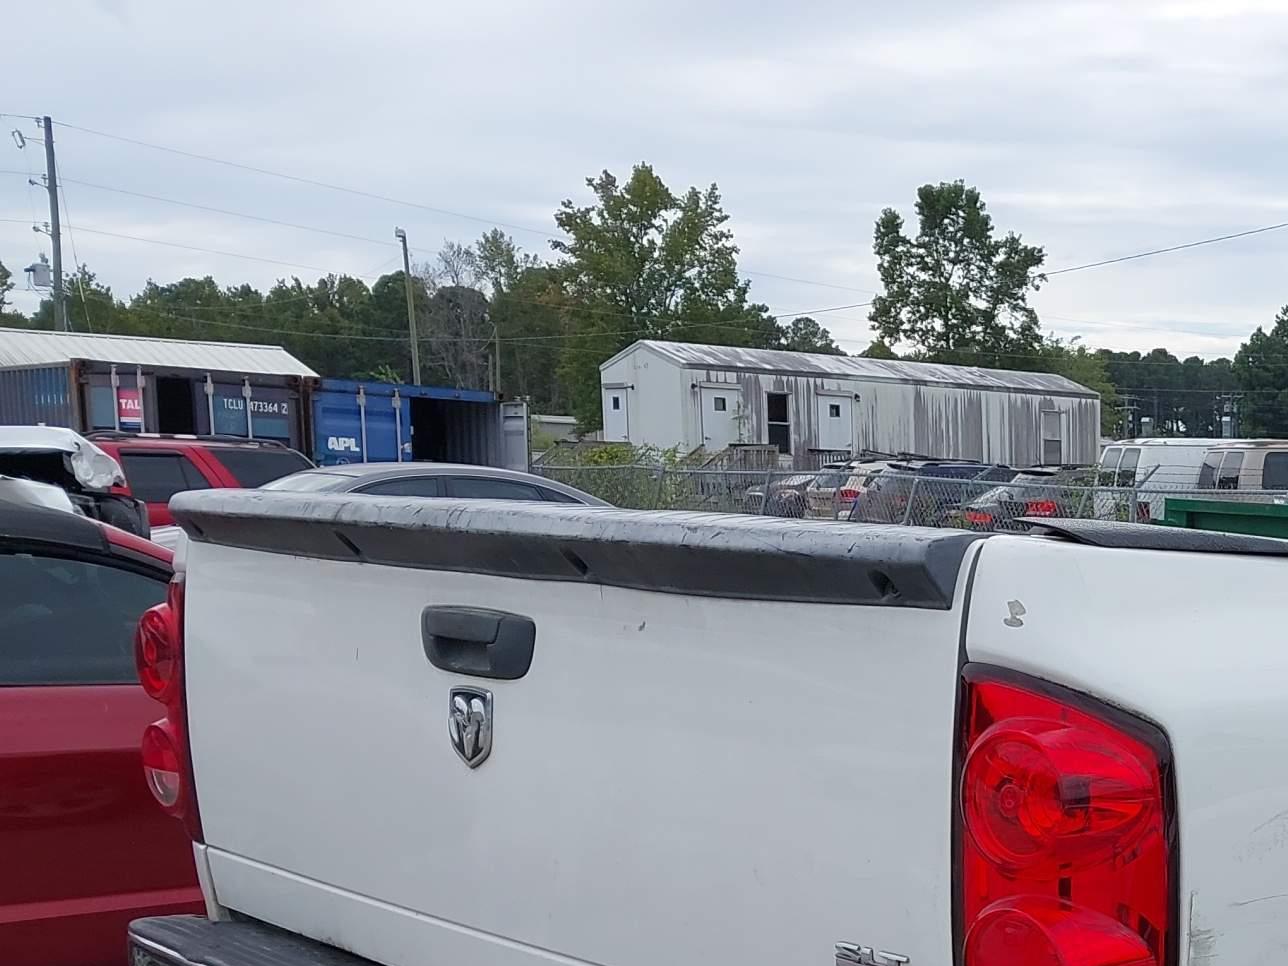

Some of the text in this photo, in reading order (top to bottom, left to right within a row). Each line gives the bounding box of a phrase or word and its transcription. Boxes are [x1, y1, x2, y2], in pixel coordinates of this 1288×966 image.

[119, 398, 141, 410] TAL
[223, 398, 244, 410] TCLU
[328, 436, 361, 452] APL
